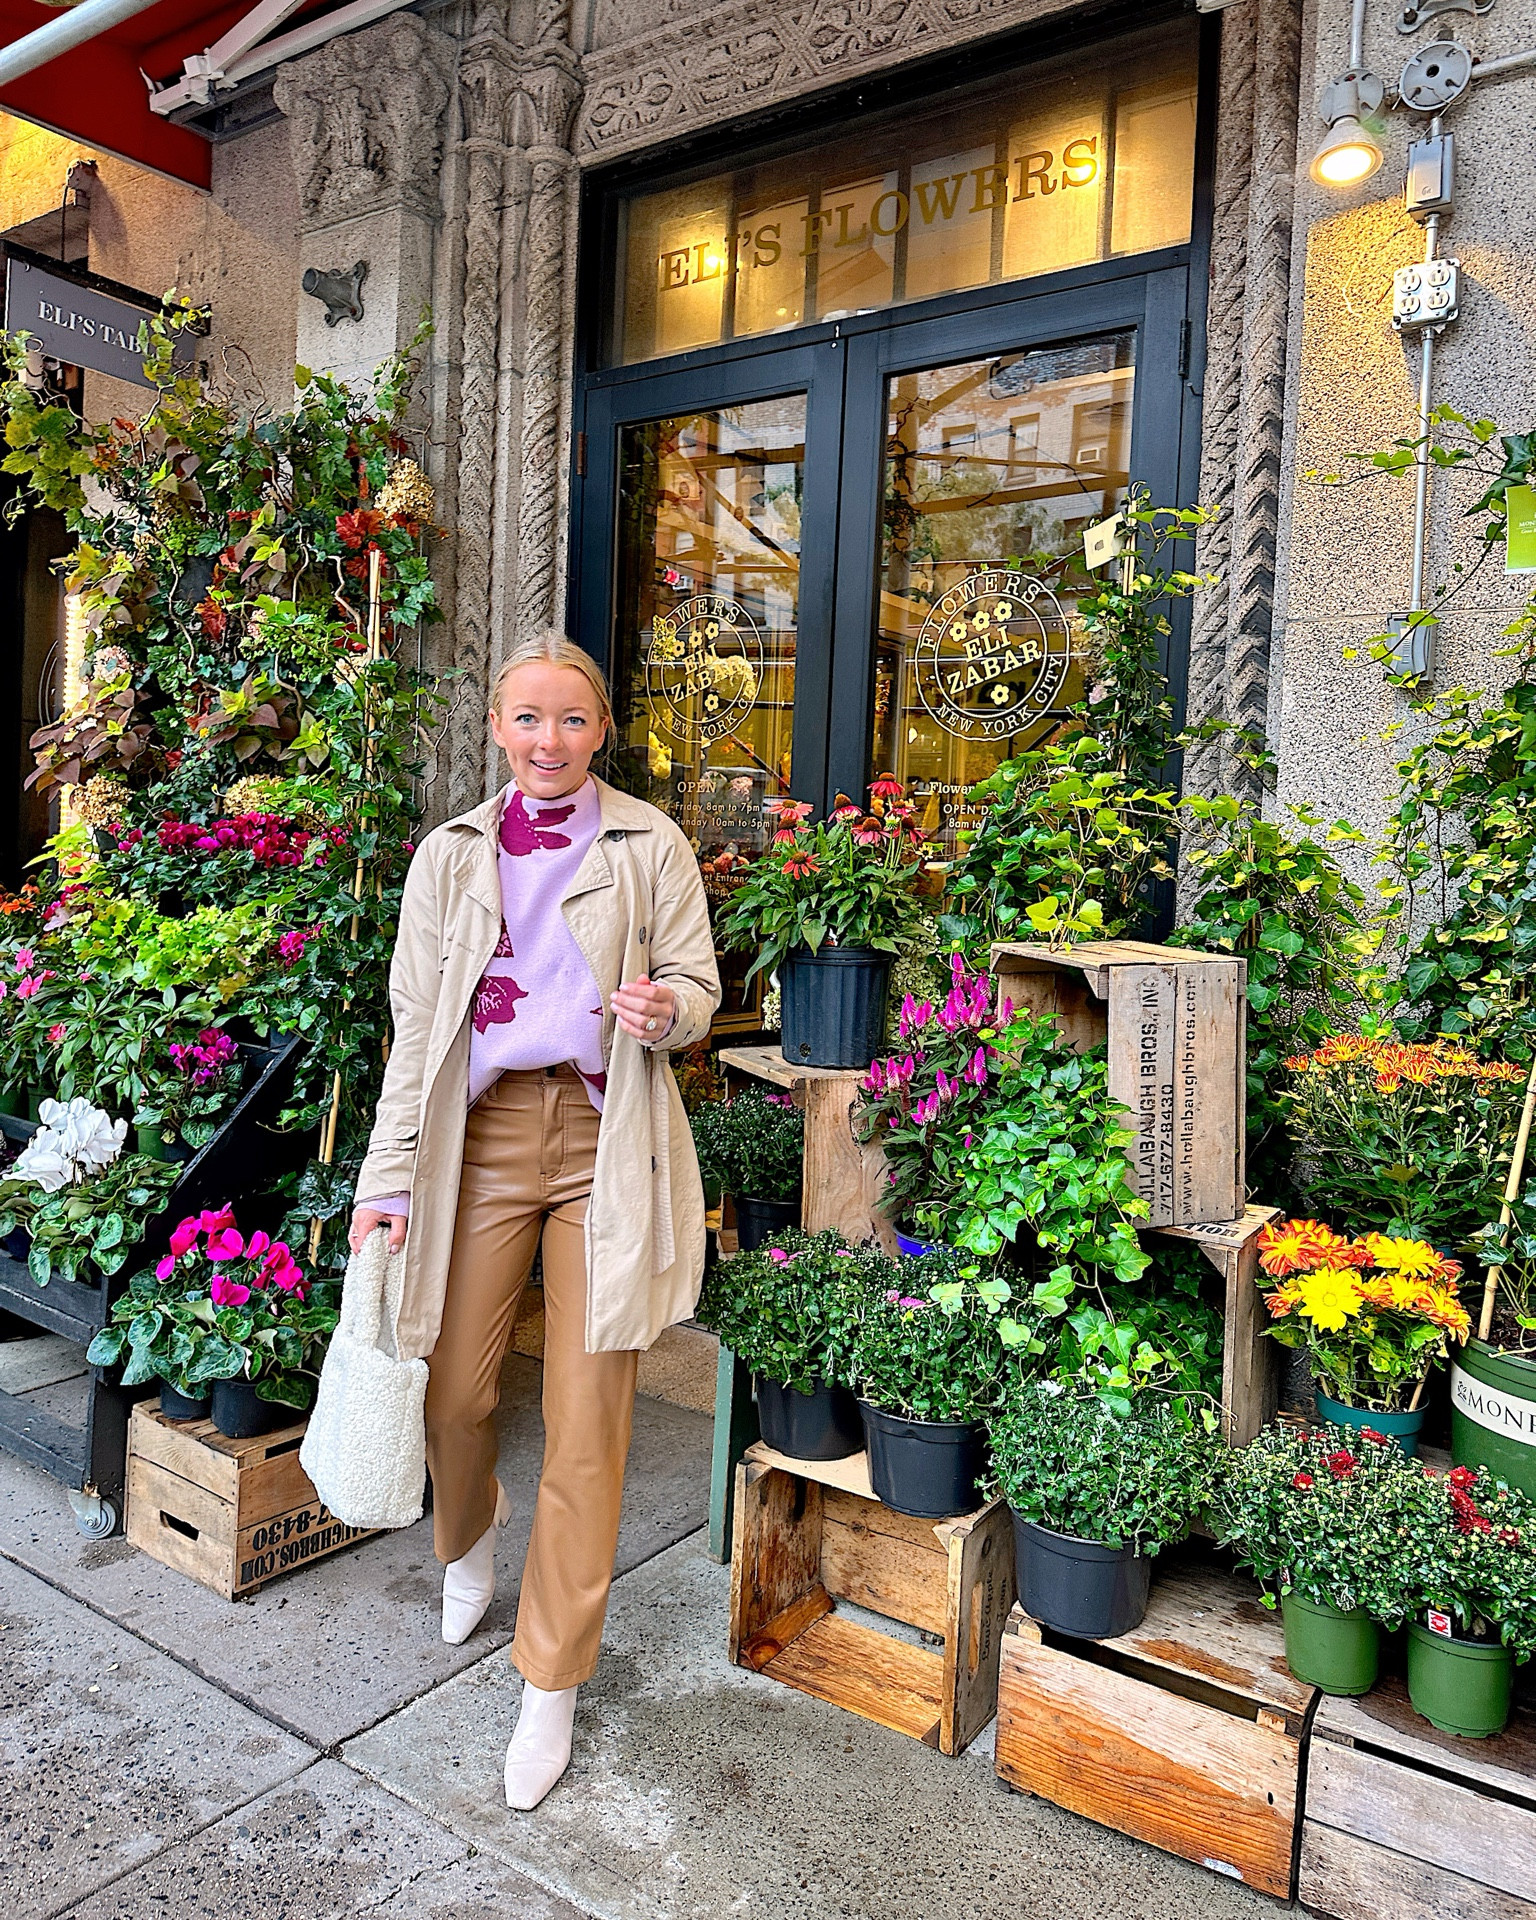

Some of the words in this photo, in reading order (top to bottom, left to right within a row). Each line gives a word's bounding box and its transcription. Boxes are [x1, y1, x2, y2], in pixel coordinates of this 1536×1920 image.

[659, 222, 781, 292] ELI'S
[800, 136, 1098, 257] FLOWERS
[37, 301, 96, 337] ELI'S
[920, 574, 1041, 651] FLOWERS
[682, 643, 717, 675] ELI
[962, 625, 1012, 662] ELI
[946, 639, 1042, 694] ZABAR
[936, 702, 974, 732] NEW
[981, 704, 1034, 735] YORK
[1034, 655, 1064, 703] CITY
[699, 711, 738, 737] YORK
[677, 781, 716, 793] OPEN
[706, 802, 725, 811] 8am
[728, 802, 738, 811] to
[741, 802, 760, 813] 7pm
[711, 817, 735, 827] 10am
[738, 818, 748, 827] to
[751, 818, 770, 829] 5pm
[943, 803, 976, 815] OPEN
[948, 817, 969, 828] 8am
[1180, 975, 1197, 1215] www.hollabaughbros.com
